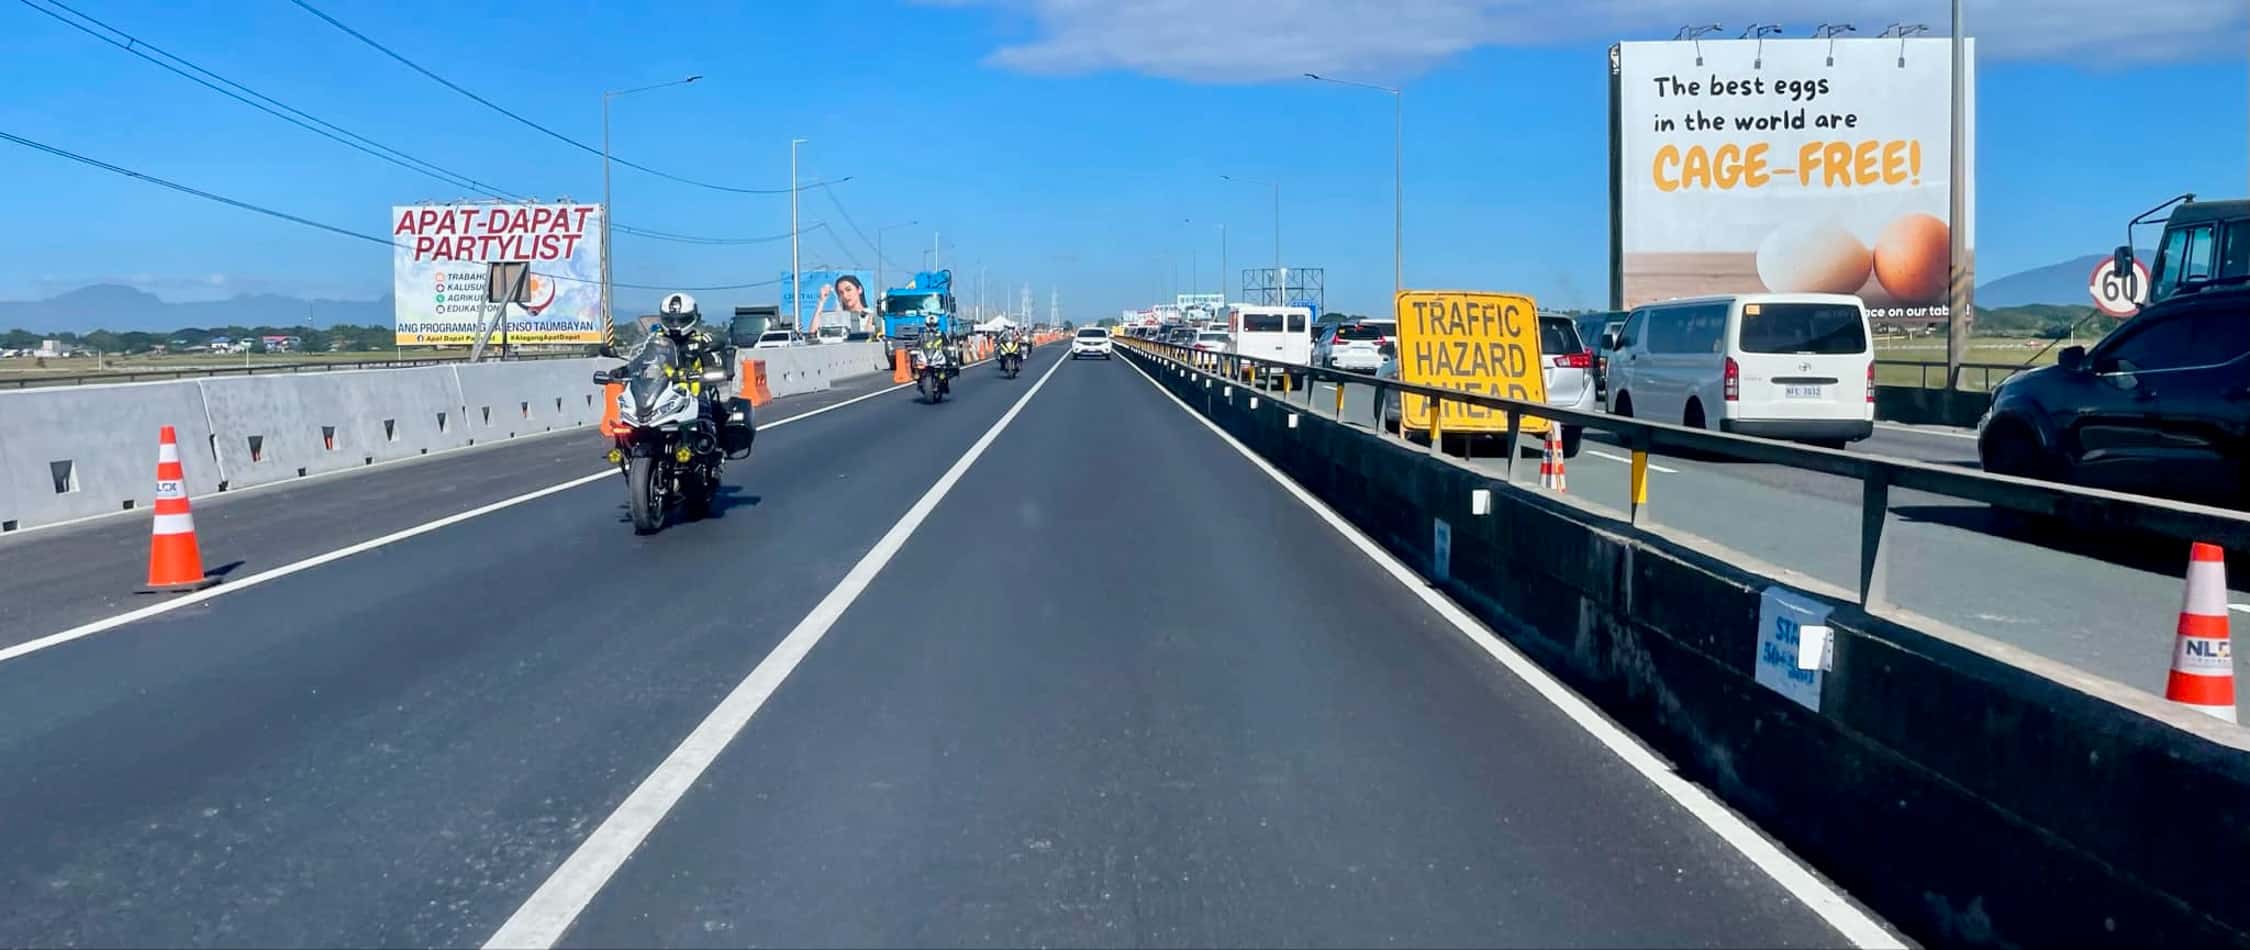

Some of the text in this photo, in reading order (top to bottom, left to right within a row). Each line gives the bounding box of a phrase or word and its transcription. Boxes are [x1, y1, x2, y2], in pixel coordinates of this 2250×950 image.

[1653, 74, 1830, 101] The best eggs
[1653, 108, 1858, 132] in the world are
[1653, 140, 1922, 192] CAGE-FREE!
[395, 208, 593, 235] APAT-DAPAT
[415, 234, 582, 261] PARTYLIST
[2102, 270, 2138, 302] 60
[1412, 301, 1521, 338] TRAFFIC
[1888, 308, 1904, 317] on
[1906, 308, 1927, 317] our
[398, 322, 418, 333] ANG
[1415, 341, 1527, 378] HAZARD
